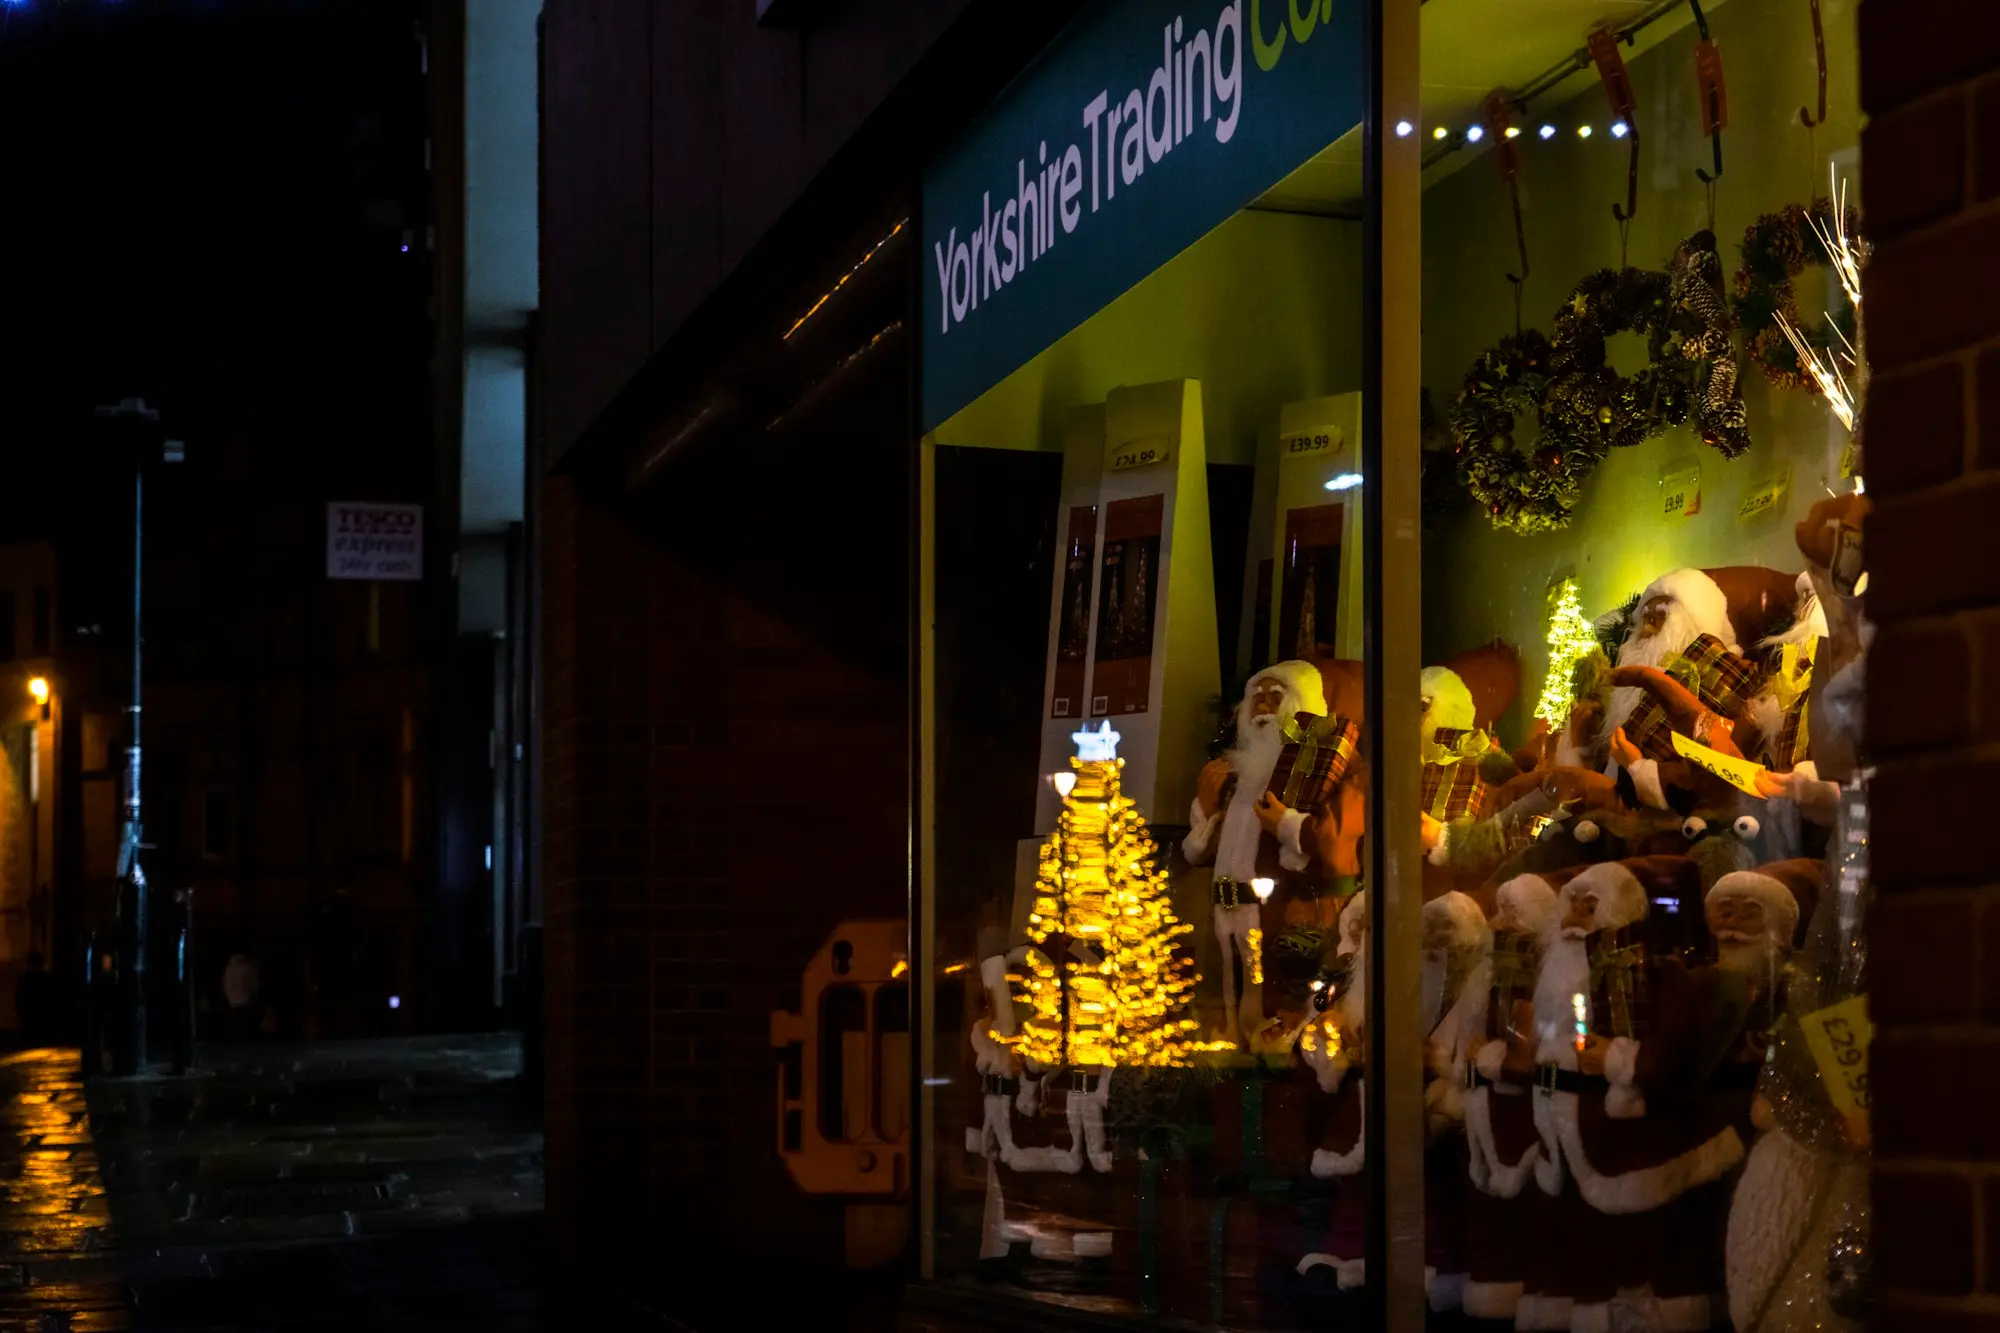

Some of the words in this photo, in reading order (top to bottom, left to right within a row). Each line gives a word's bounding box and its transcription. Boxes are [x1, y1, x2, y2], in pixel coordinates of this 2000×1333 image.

[935, 141, 1083, 334] Yorkshire
[1083, 0, 1242, 214] Trading
[1290, 434, 1329, 452] £39.99
[337, 508, 416, 526] TESCO
[335, 536, 415, 557] express
